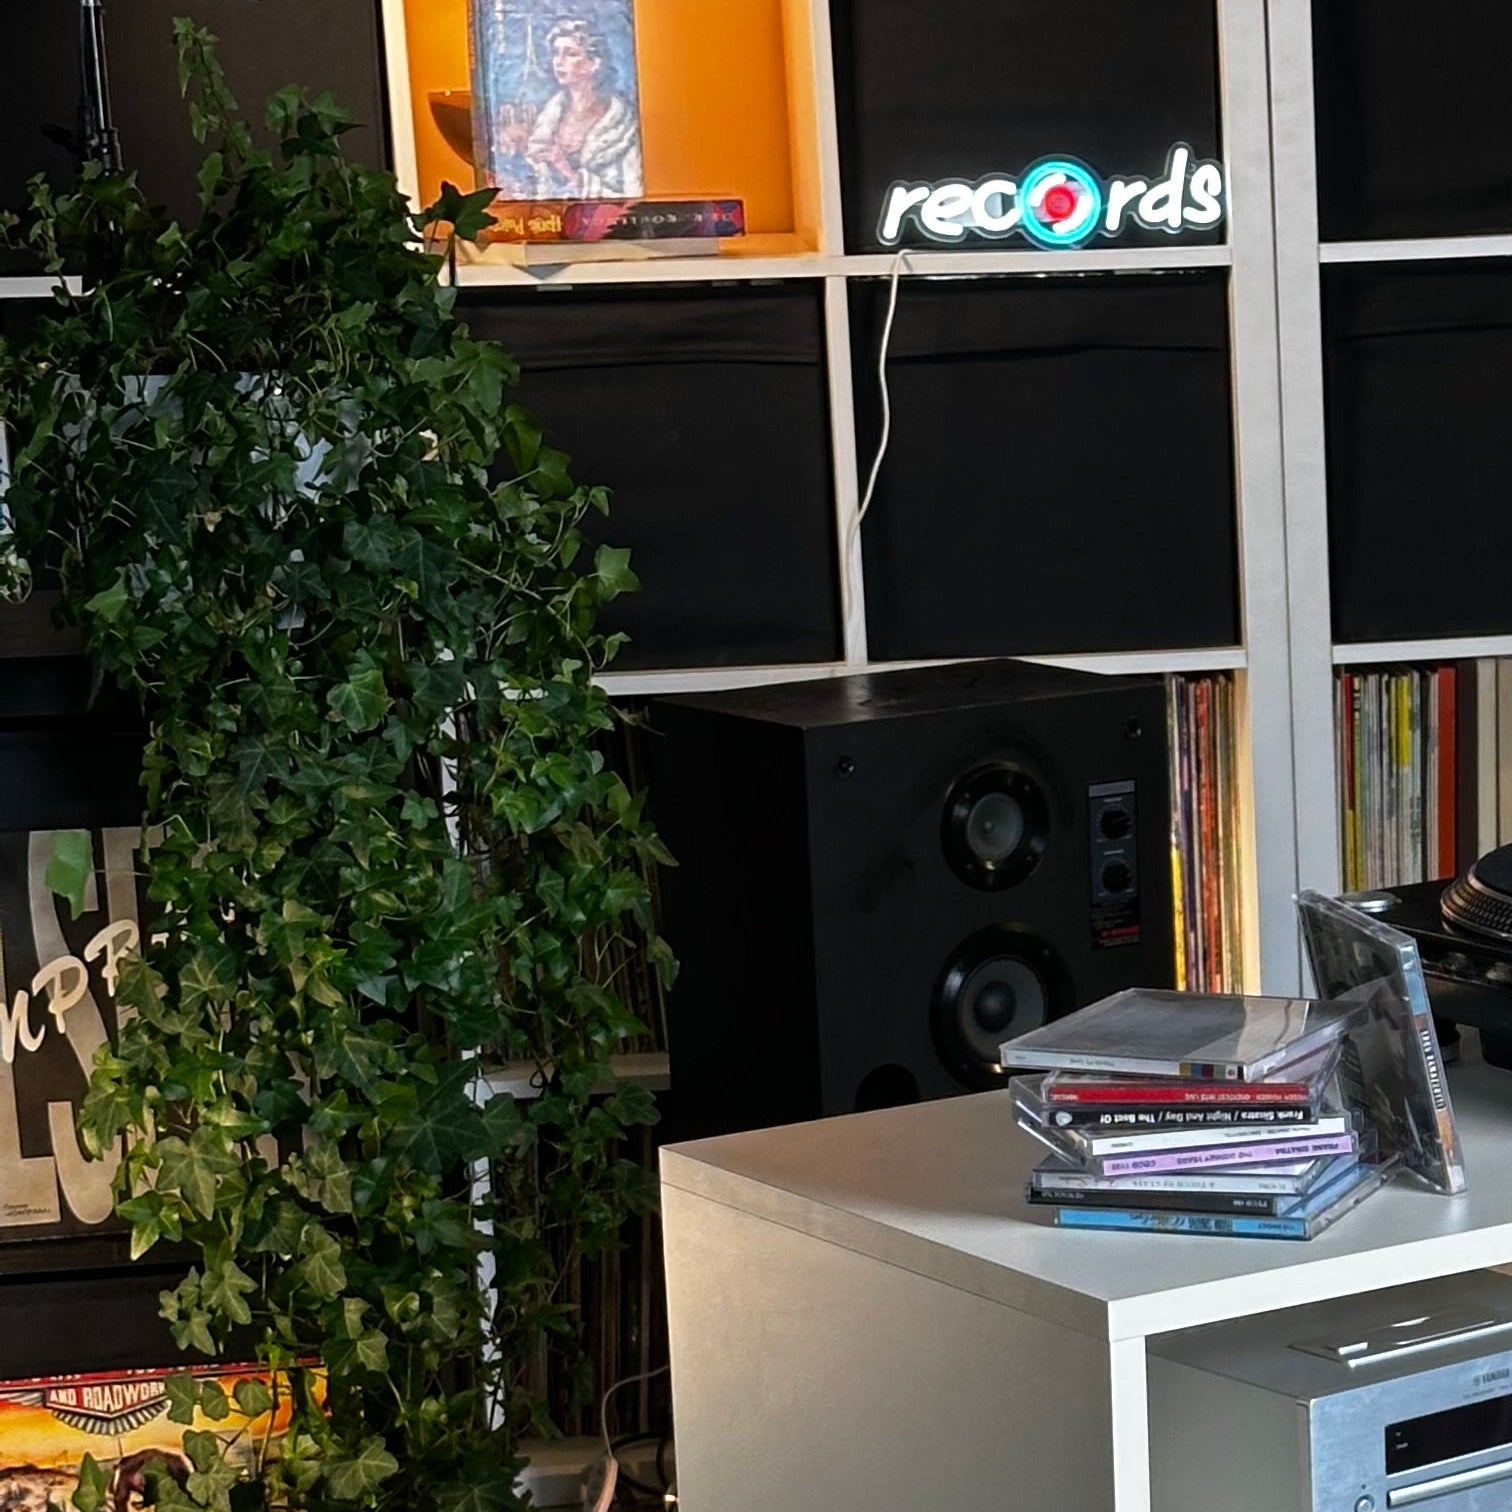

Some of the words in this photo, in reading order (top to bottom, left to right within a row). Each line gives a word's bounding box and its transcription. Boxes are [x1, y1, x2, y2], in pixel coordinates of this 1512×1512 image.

[883, 147, 1223, 244] records
[1099, 1113, 1112, 1124] Of
[1113, 1113, 1137, 1124] Best
[1138, 1113, 1156, 1124] The
[1165, 1111, 1184, 1123] Day
[1185, 1112, 1205, 1122] And
[1206, 1110, 1232, 1122] Night
[1241, 1111, 1275, 1121] Sinatra
[1276, 1110, 1304, 1121] Frank
[50, 1388, 77, 1406] AND
